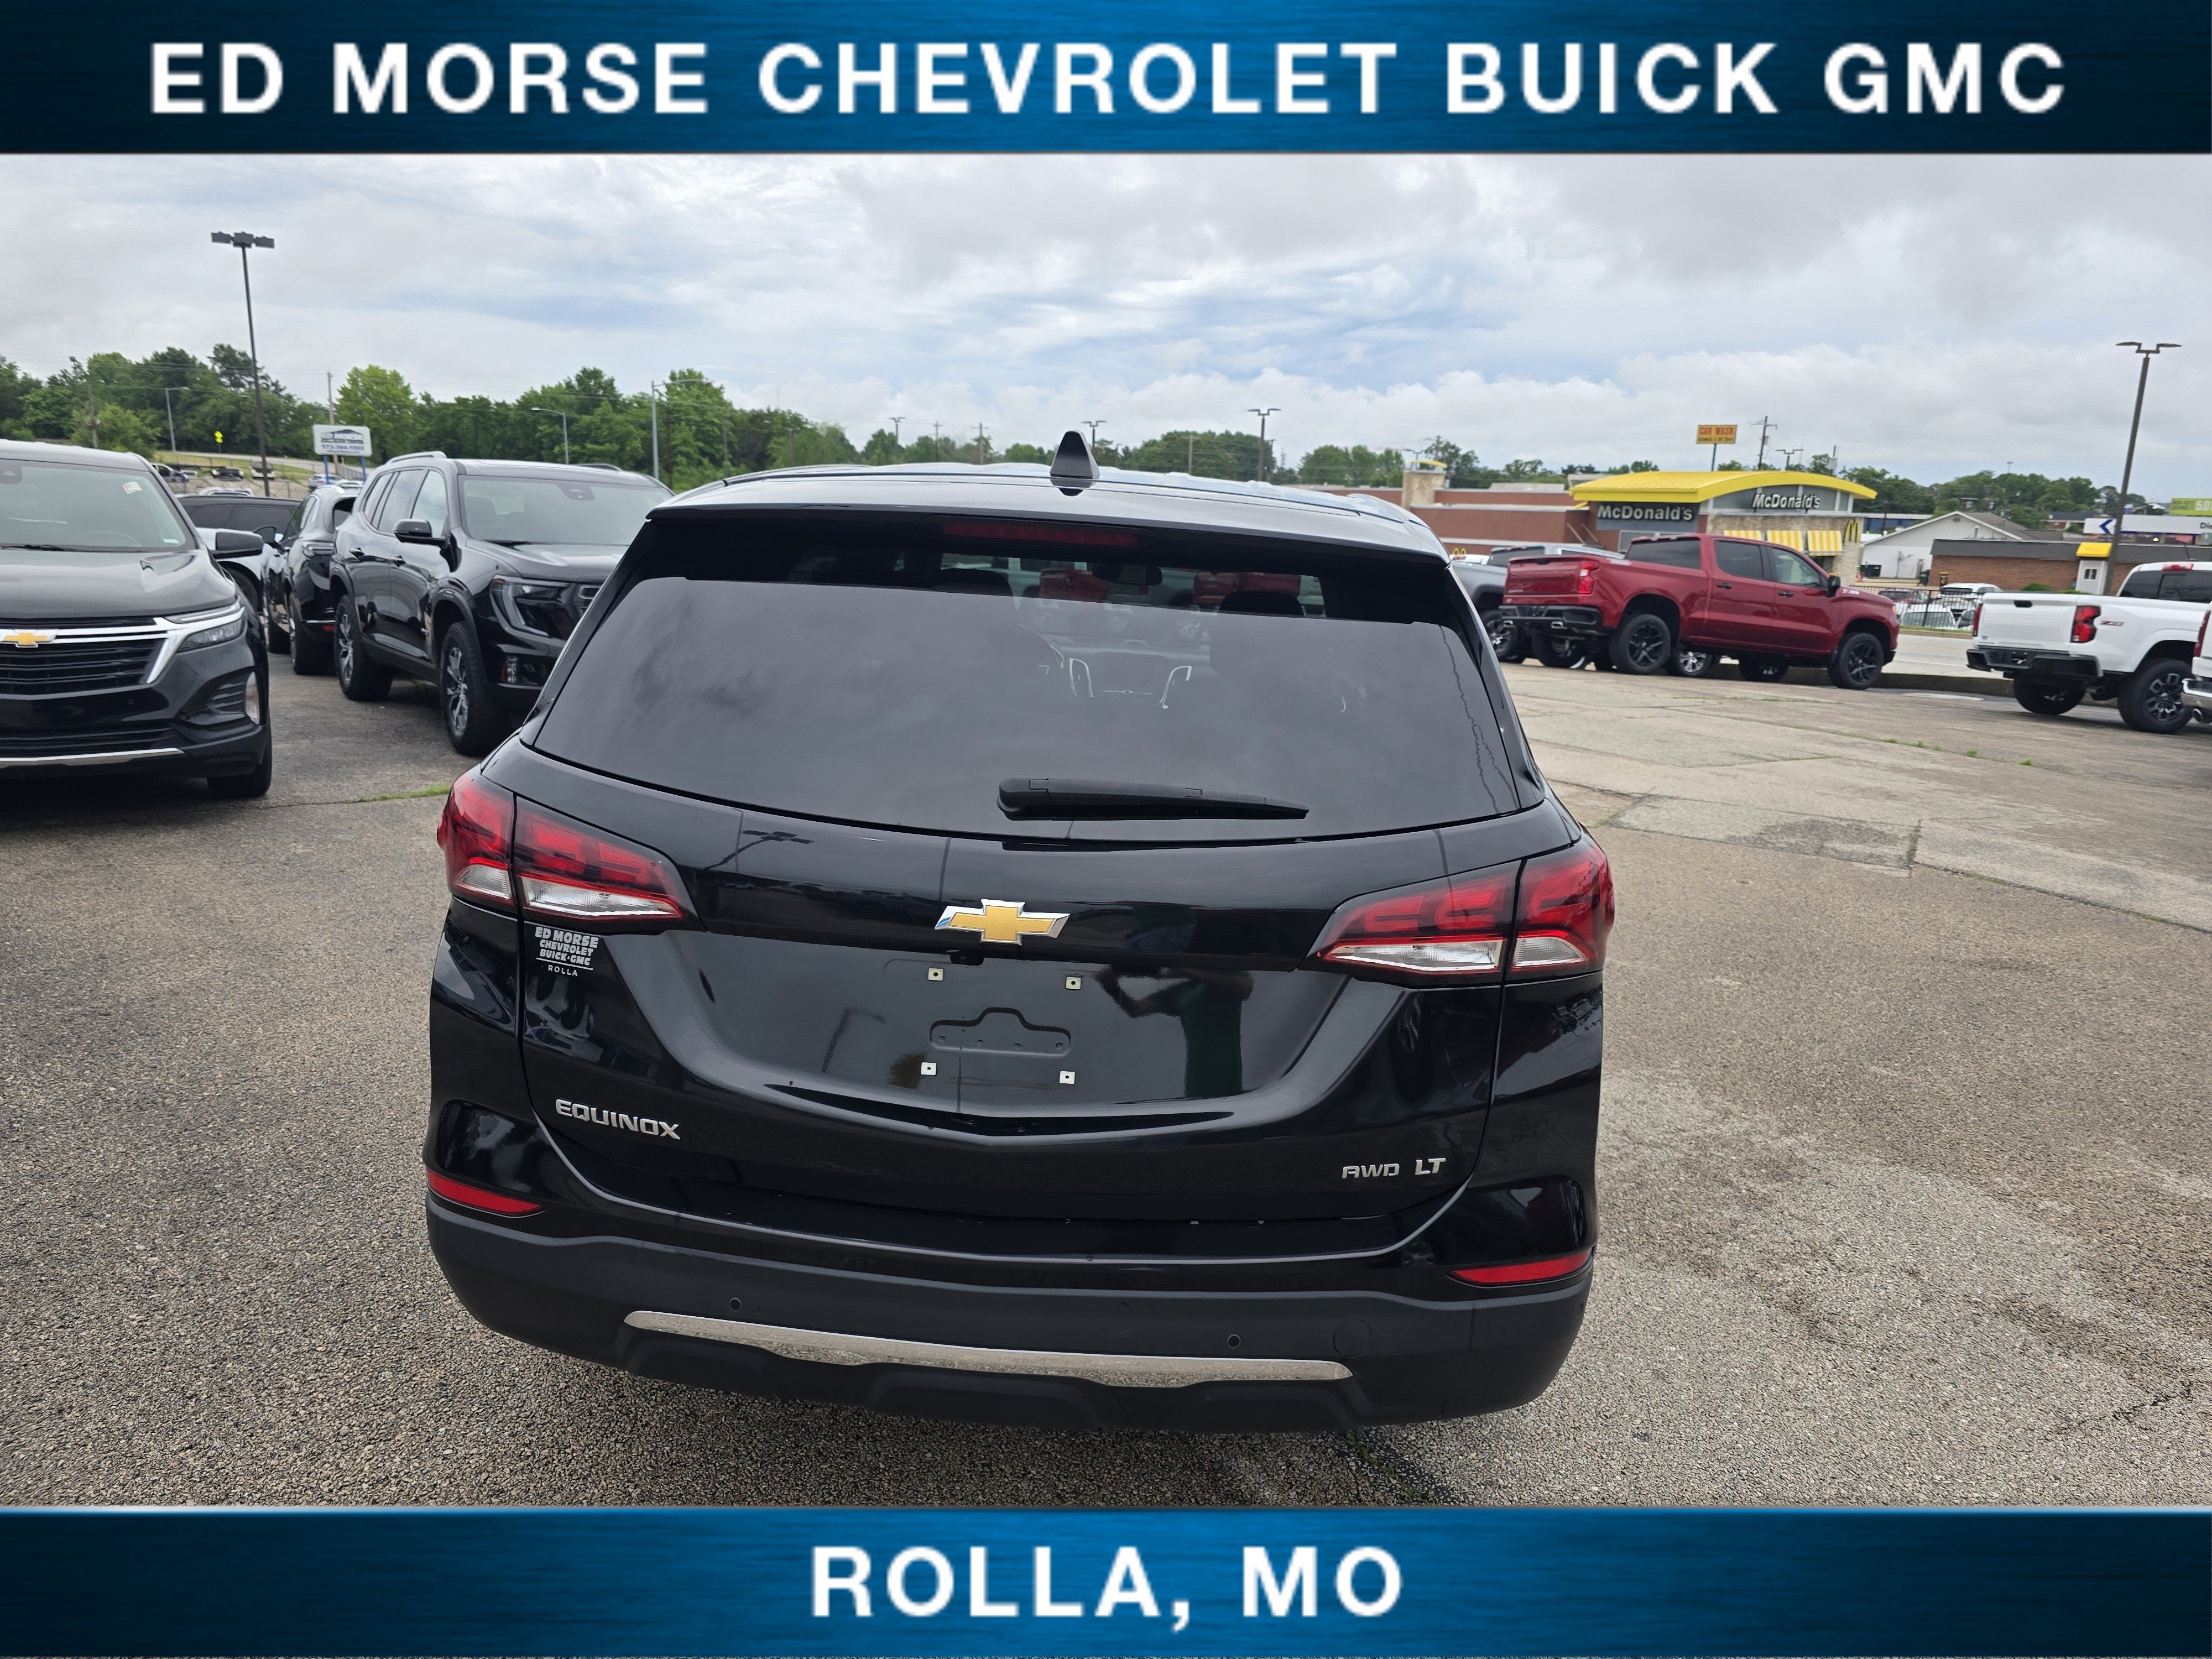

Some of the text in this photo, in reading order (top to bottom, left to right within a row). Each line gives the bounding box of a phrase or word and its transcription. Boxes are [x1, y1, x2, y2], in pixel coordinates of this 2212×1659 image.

[1752, 493, 1821, 509] McDonald's
[2195, 500, 2212, 512] 5.0
[1597, 504, 1693, 521] McDonald's
[535, 926, 599, 948] ED MORSE
[539, 939, 594, 957] CHEVROLET
[548, 964, 578, 977] ROLLA
[555, 1099, 681, 1140] EQUINOX
[1342, 1157, 1446, 1179] AWD LT
